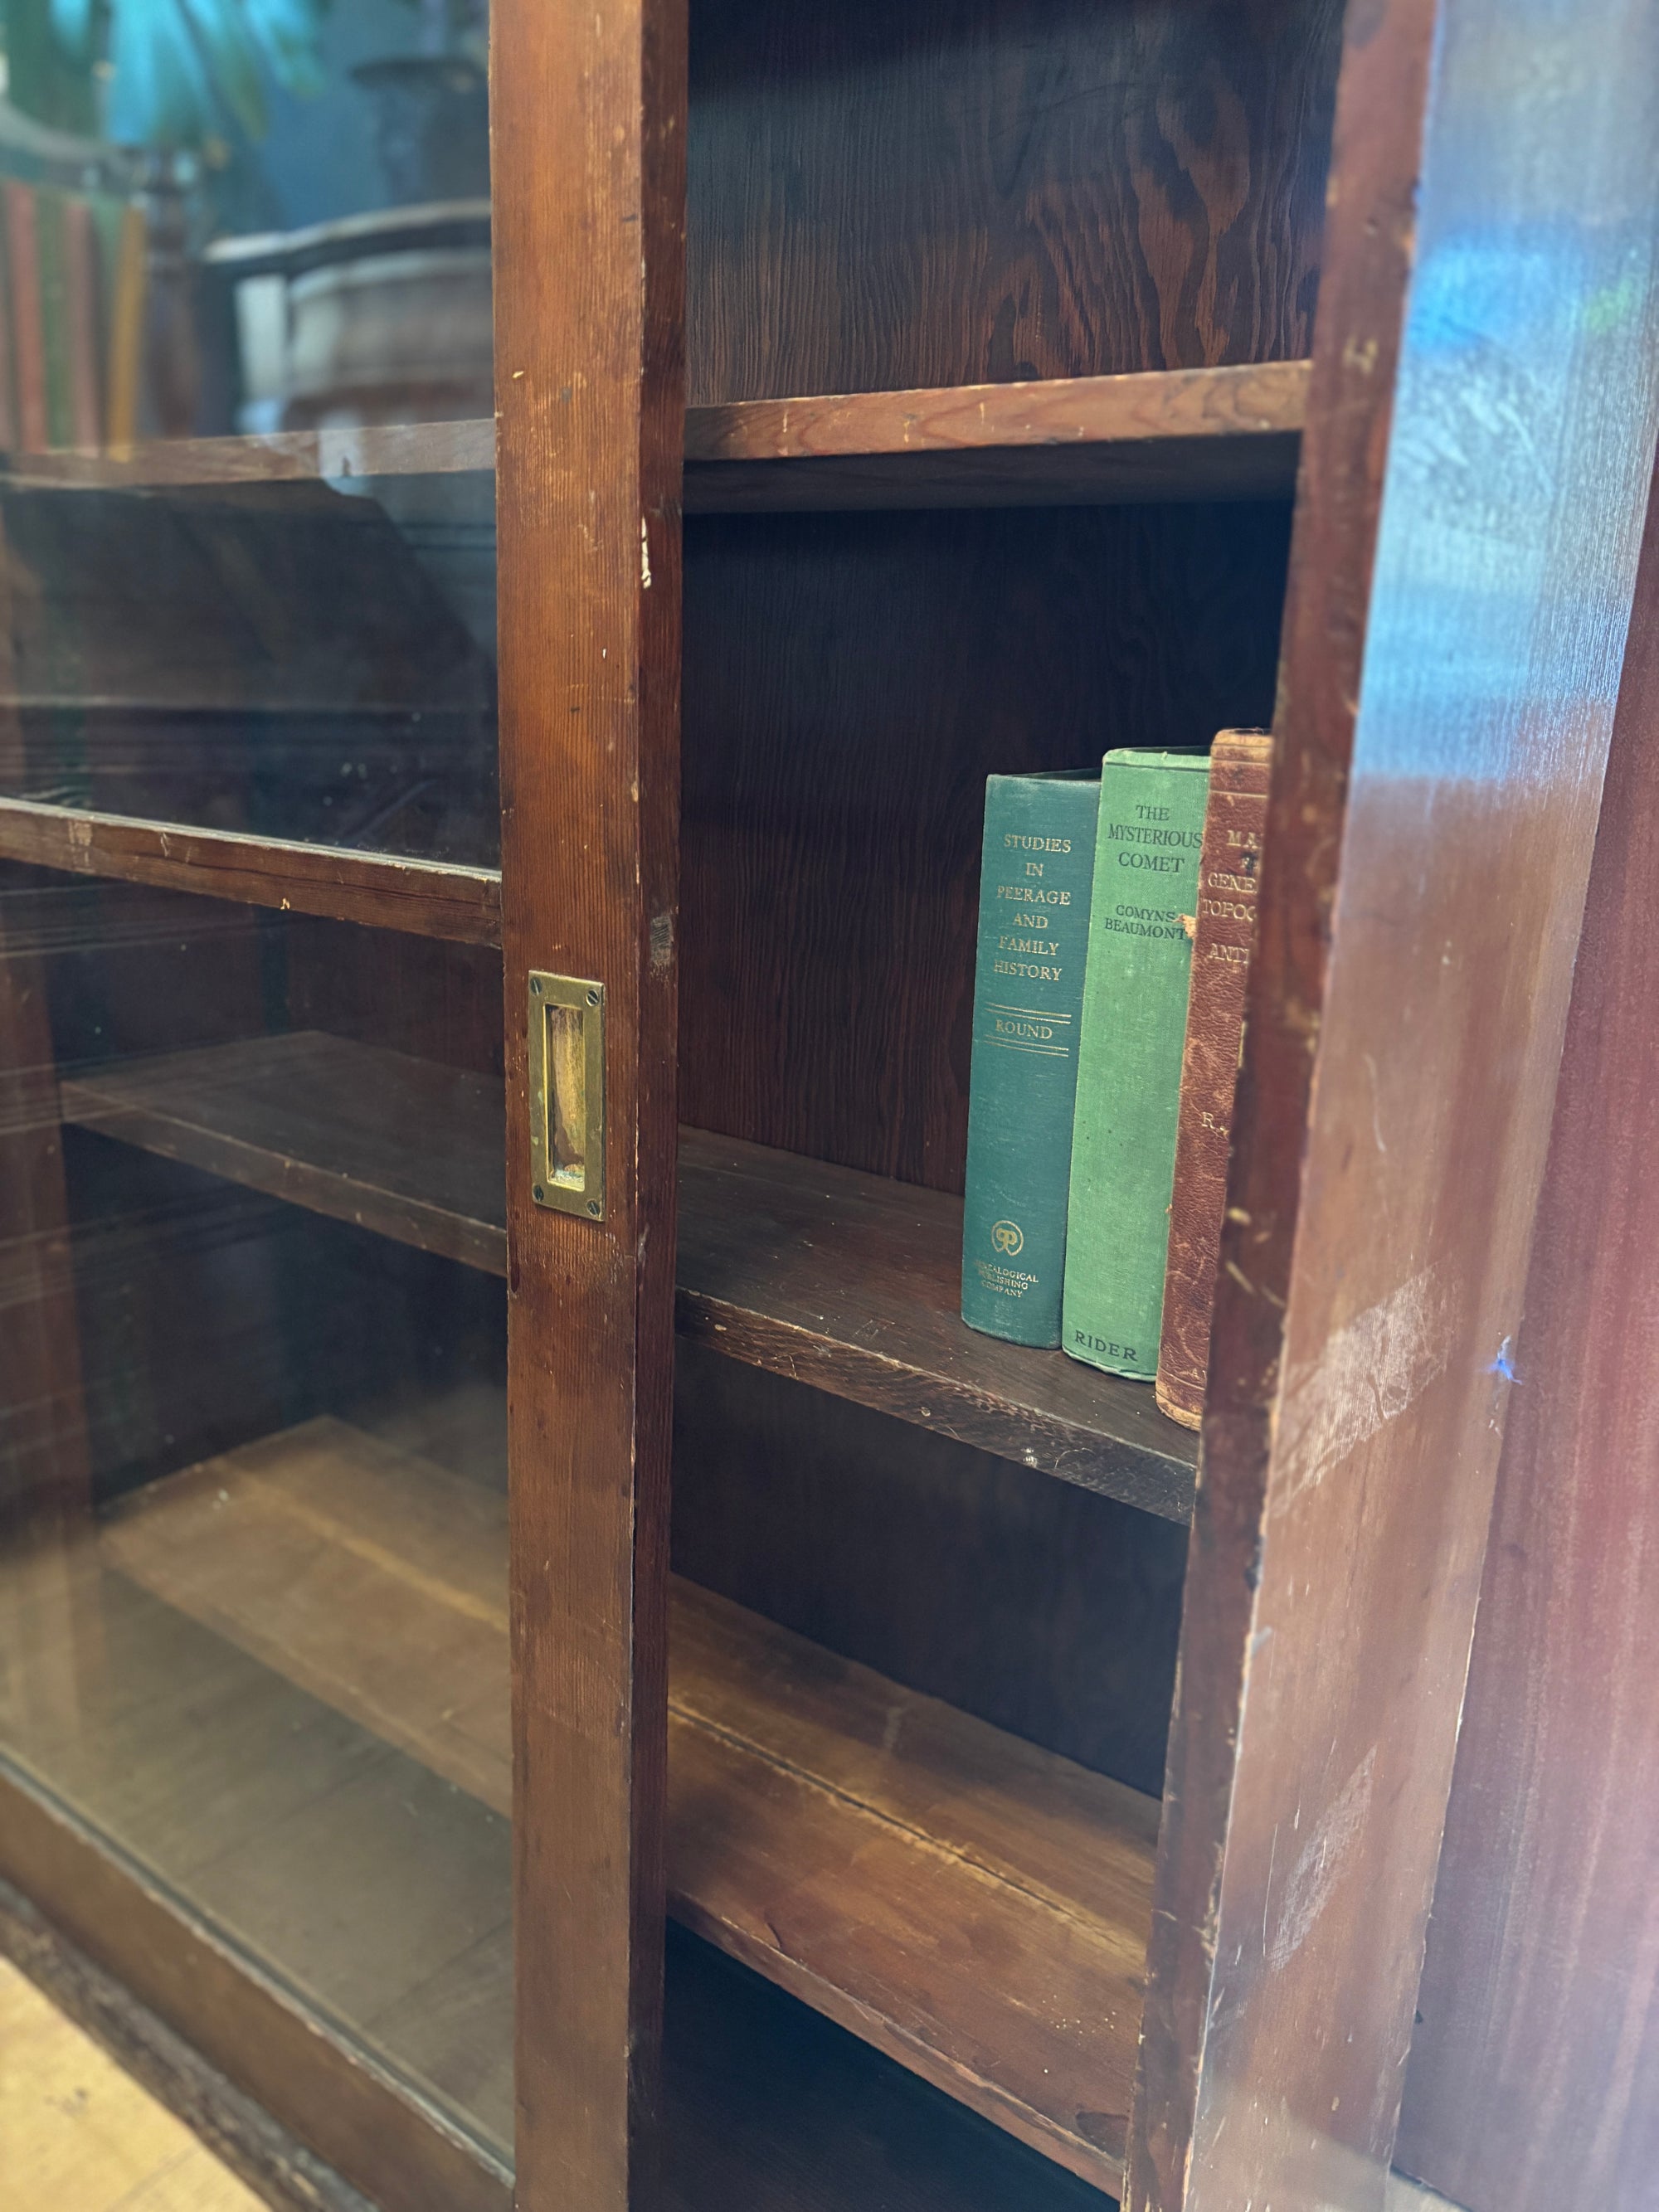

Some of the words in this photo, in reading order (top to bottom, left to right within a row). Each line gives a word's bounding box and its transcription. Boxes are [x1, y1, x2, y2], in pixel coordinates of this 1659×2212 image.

[1136, 805, 1170, 821] THE
[1004, 834, 1072, 853] STUDIES
[1107, 824, 1203, 848] MYSTERIOUS
[1025, 863, 1043, 877] IN
[1118, 852, 1185, 873] COMET
[1208, 873, 1258, 893] GENE
[997, 886, 1071, 905] PEERAGE
[1012, 915, 1048, 929] AND
[1116, 905, 1175, 922] COMYNS
[1105, 918, 1186, 941] BEAUMONT
[999, 936, 1059, 956] FAMILY
[993, 960, 1063, 981] HISTORY
[996, 1019, 1053, 1039] ROUND
[974, 1259, 1039, 1283] EALOGICAL
[1075, 1330, 1138, 1362] RIDER
